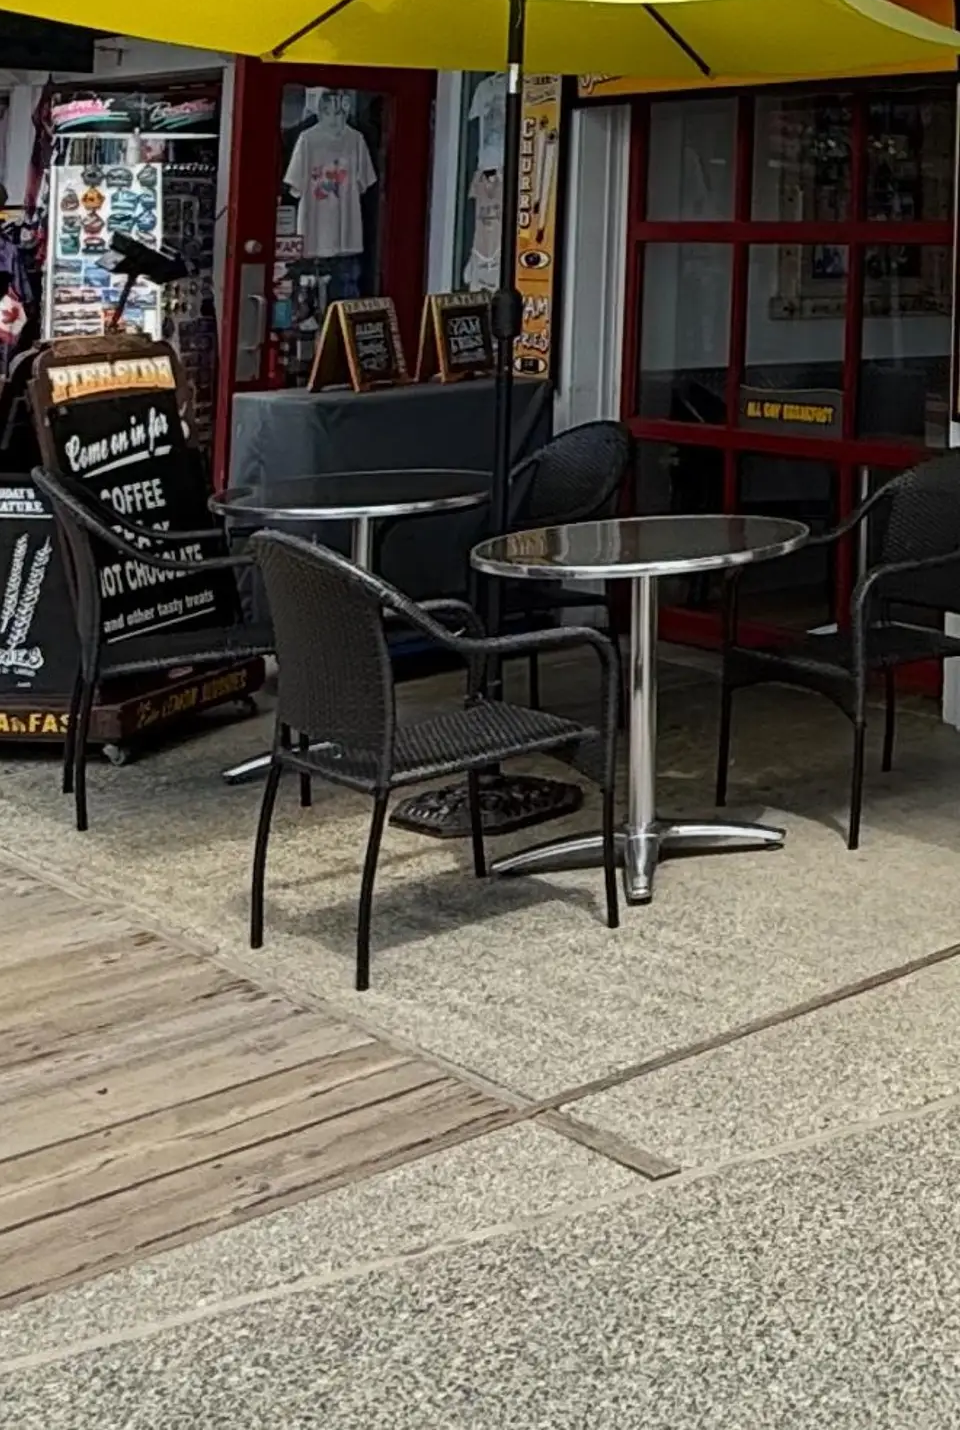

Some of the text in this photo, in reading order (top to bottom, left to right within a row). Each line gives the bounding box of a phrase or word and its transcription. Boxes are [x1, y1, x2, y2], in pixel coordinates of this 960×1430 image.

[47, 356, 175, 404] PIERSIDE
[65, 406, 168, 472] Come on in for
[103, 589, 214, 633] and other tasty treats
